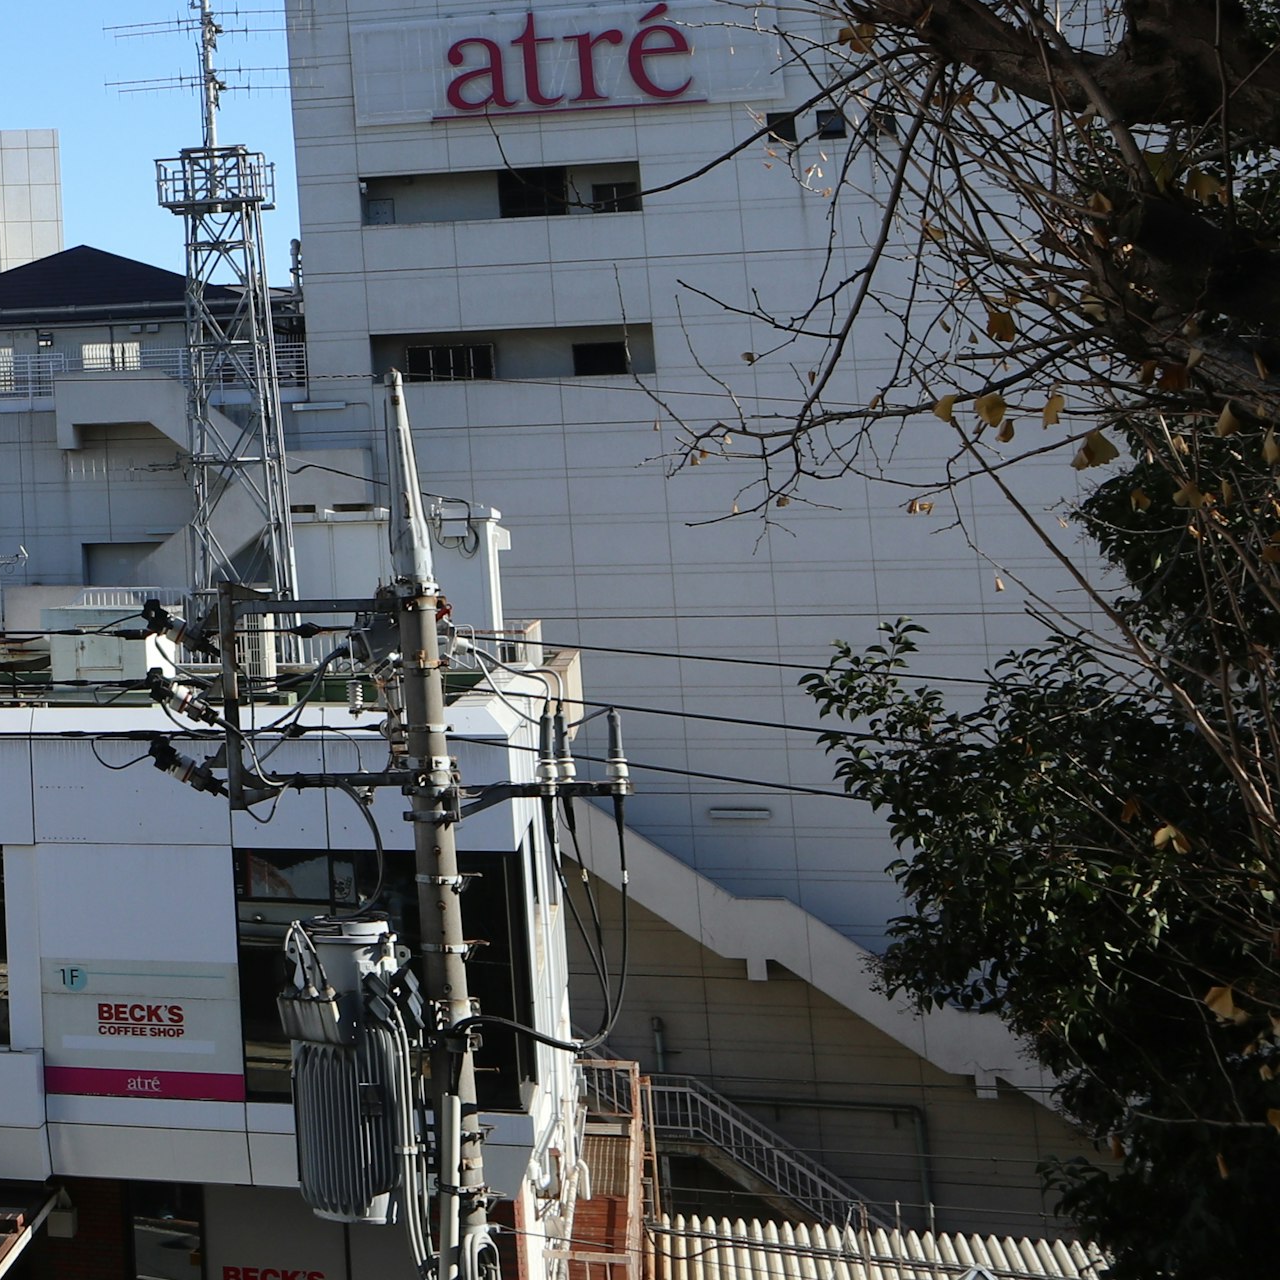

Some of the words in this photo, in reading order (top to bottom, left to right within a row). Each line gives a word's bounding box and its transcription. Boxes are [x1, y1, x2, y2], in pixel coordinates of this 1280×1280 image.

[447, 3, 693, 111] atré
[60, 968, 79, 986] 1F
[97, 1003, 184, 1024] BECK'S
[98, 1025, 147, 1037] COFFEE
[149, 1026, 185, 1038] SHOP
[126, 1076, 162, 1091] atré
